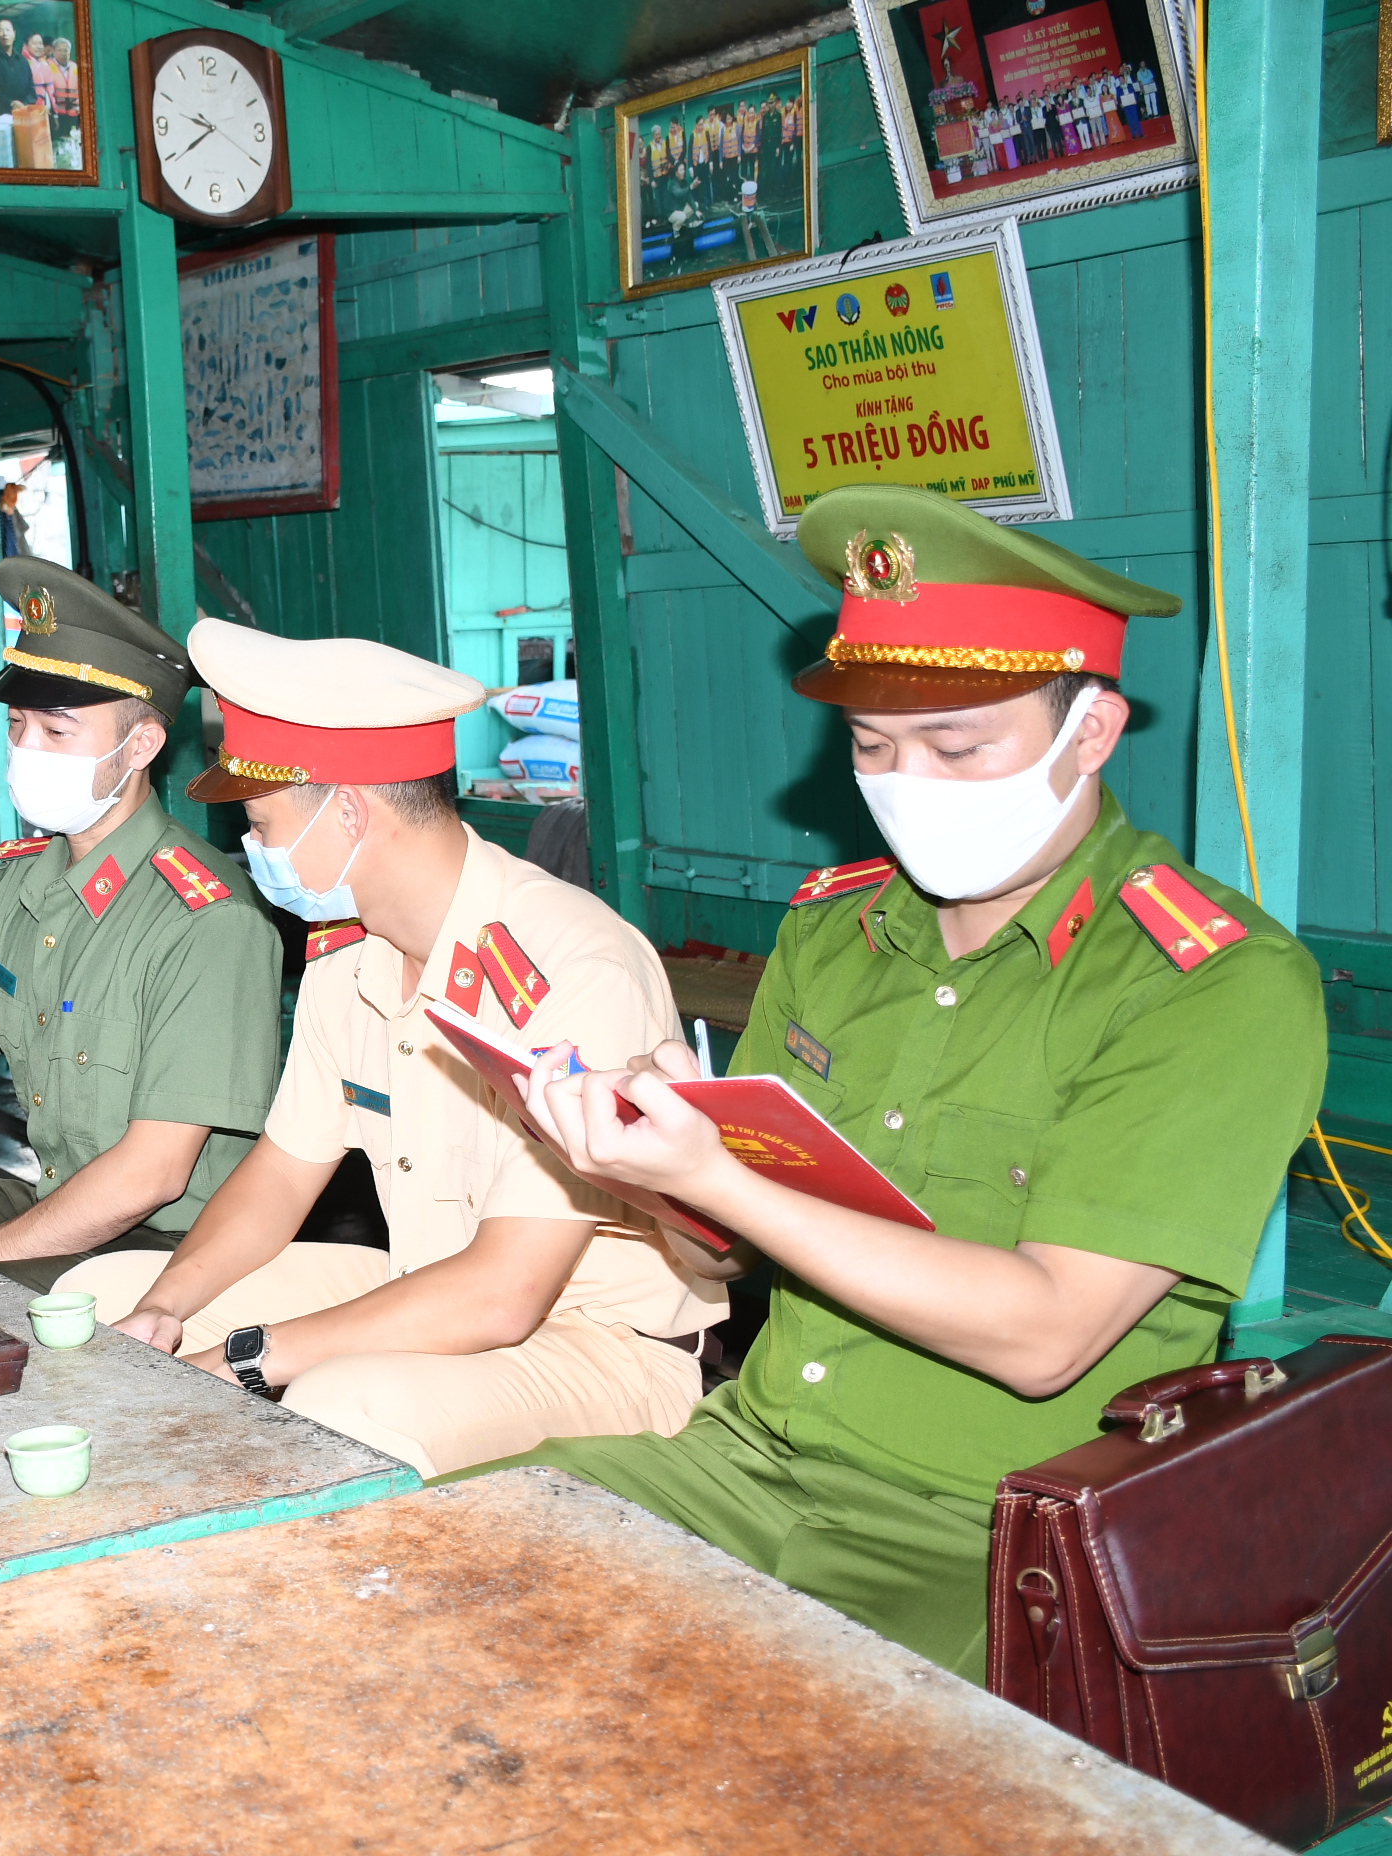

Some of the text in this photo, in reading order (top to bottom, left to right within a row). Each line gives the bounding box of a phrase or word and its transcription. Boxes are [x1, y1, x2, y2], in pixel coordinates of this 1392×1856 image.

[198, 56, 217, 76] 12
[156, 116, 169, 136] 9
[253, 123, 266, 143] 3
[209, 183, 221, 203] 6
[776, 305, 818, 333] VTV
[805, 325, 945, 371] SAO THẦN NÔNG
[822, 361, 936, 390] Cho mùa bội thu
[856, 395, 913, 418] KÍNH TẶNG
[803, 410, 990, 471] 5 TRIỆU ĐỒNG
[926, 478, 948, 493] PHÚ
[950, 476, 966, 492] MỸ
[971, 477, 990, 491] DAP
[992, 472, 1016, 488] PHÚ
[1018, 470, 1035, 486] MỸ
[720, 1124, 735, 1133] BỘ
[737, 1126, 755, 1136] THỊ
[757, 1131, 784, 1144] TRẤN
[782, 1142, 803, 1153] CÁT
